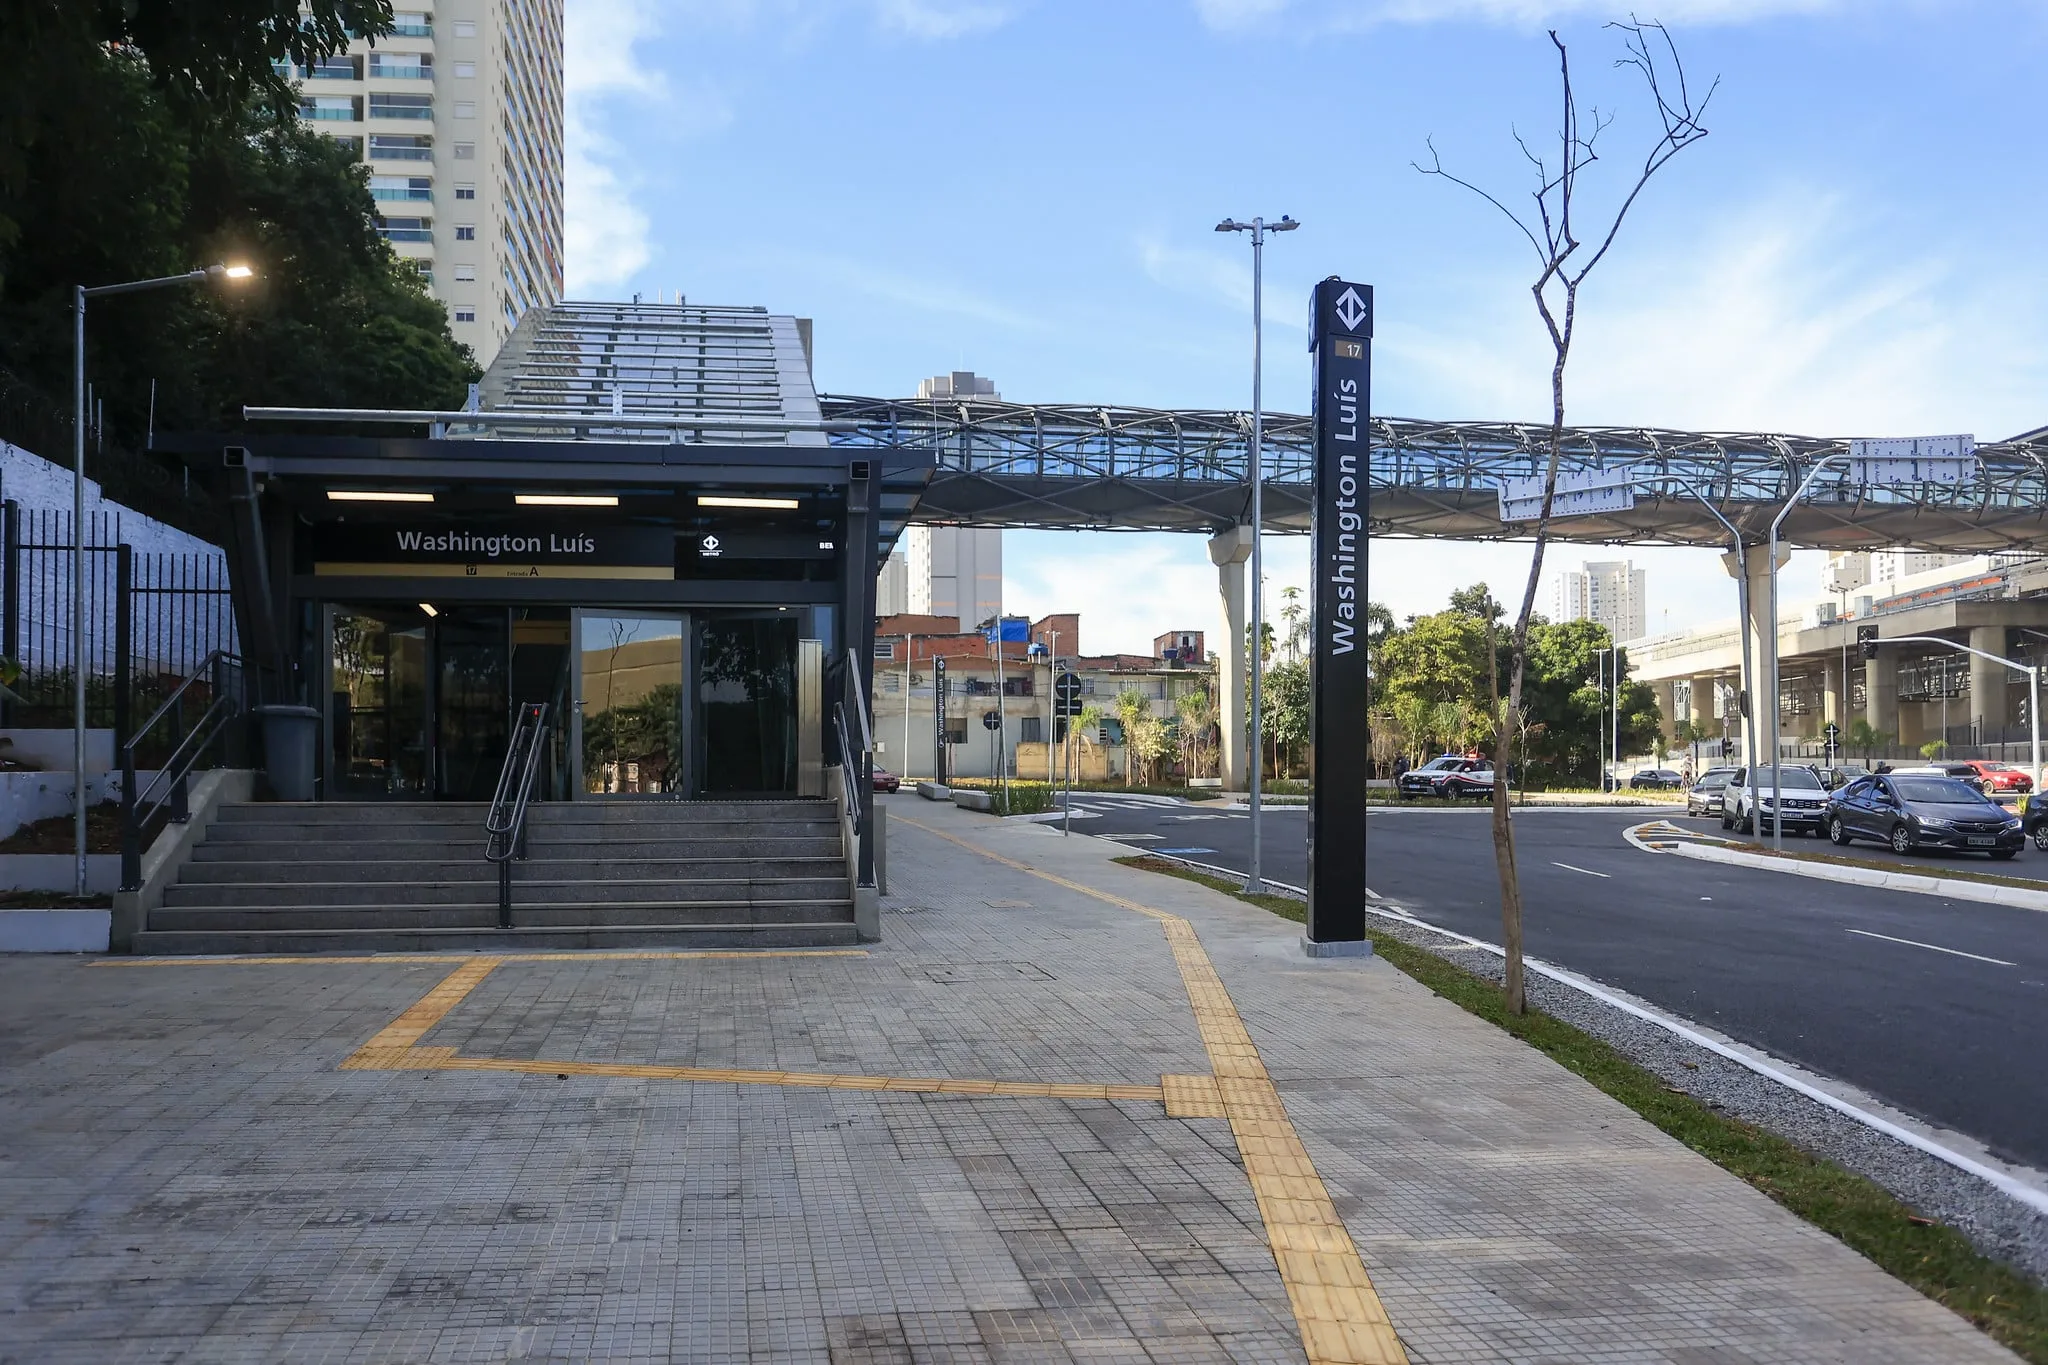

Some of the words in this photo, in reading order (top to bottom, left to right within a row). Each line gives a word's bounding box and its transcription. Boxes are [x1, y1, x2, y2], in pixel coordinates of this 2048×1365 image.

[1346, 344, 1361, 357] 17
[1334, 378, 1358, 443] Luís
[396, 531, 541, 557] Washington
[550, 532, 595, 553] Luís
[1332, 455, 1362, 656] Washington
[466, 565, 477, 575] 17
[529, 566, 539, 577] A
